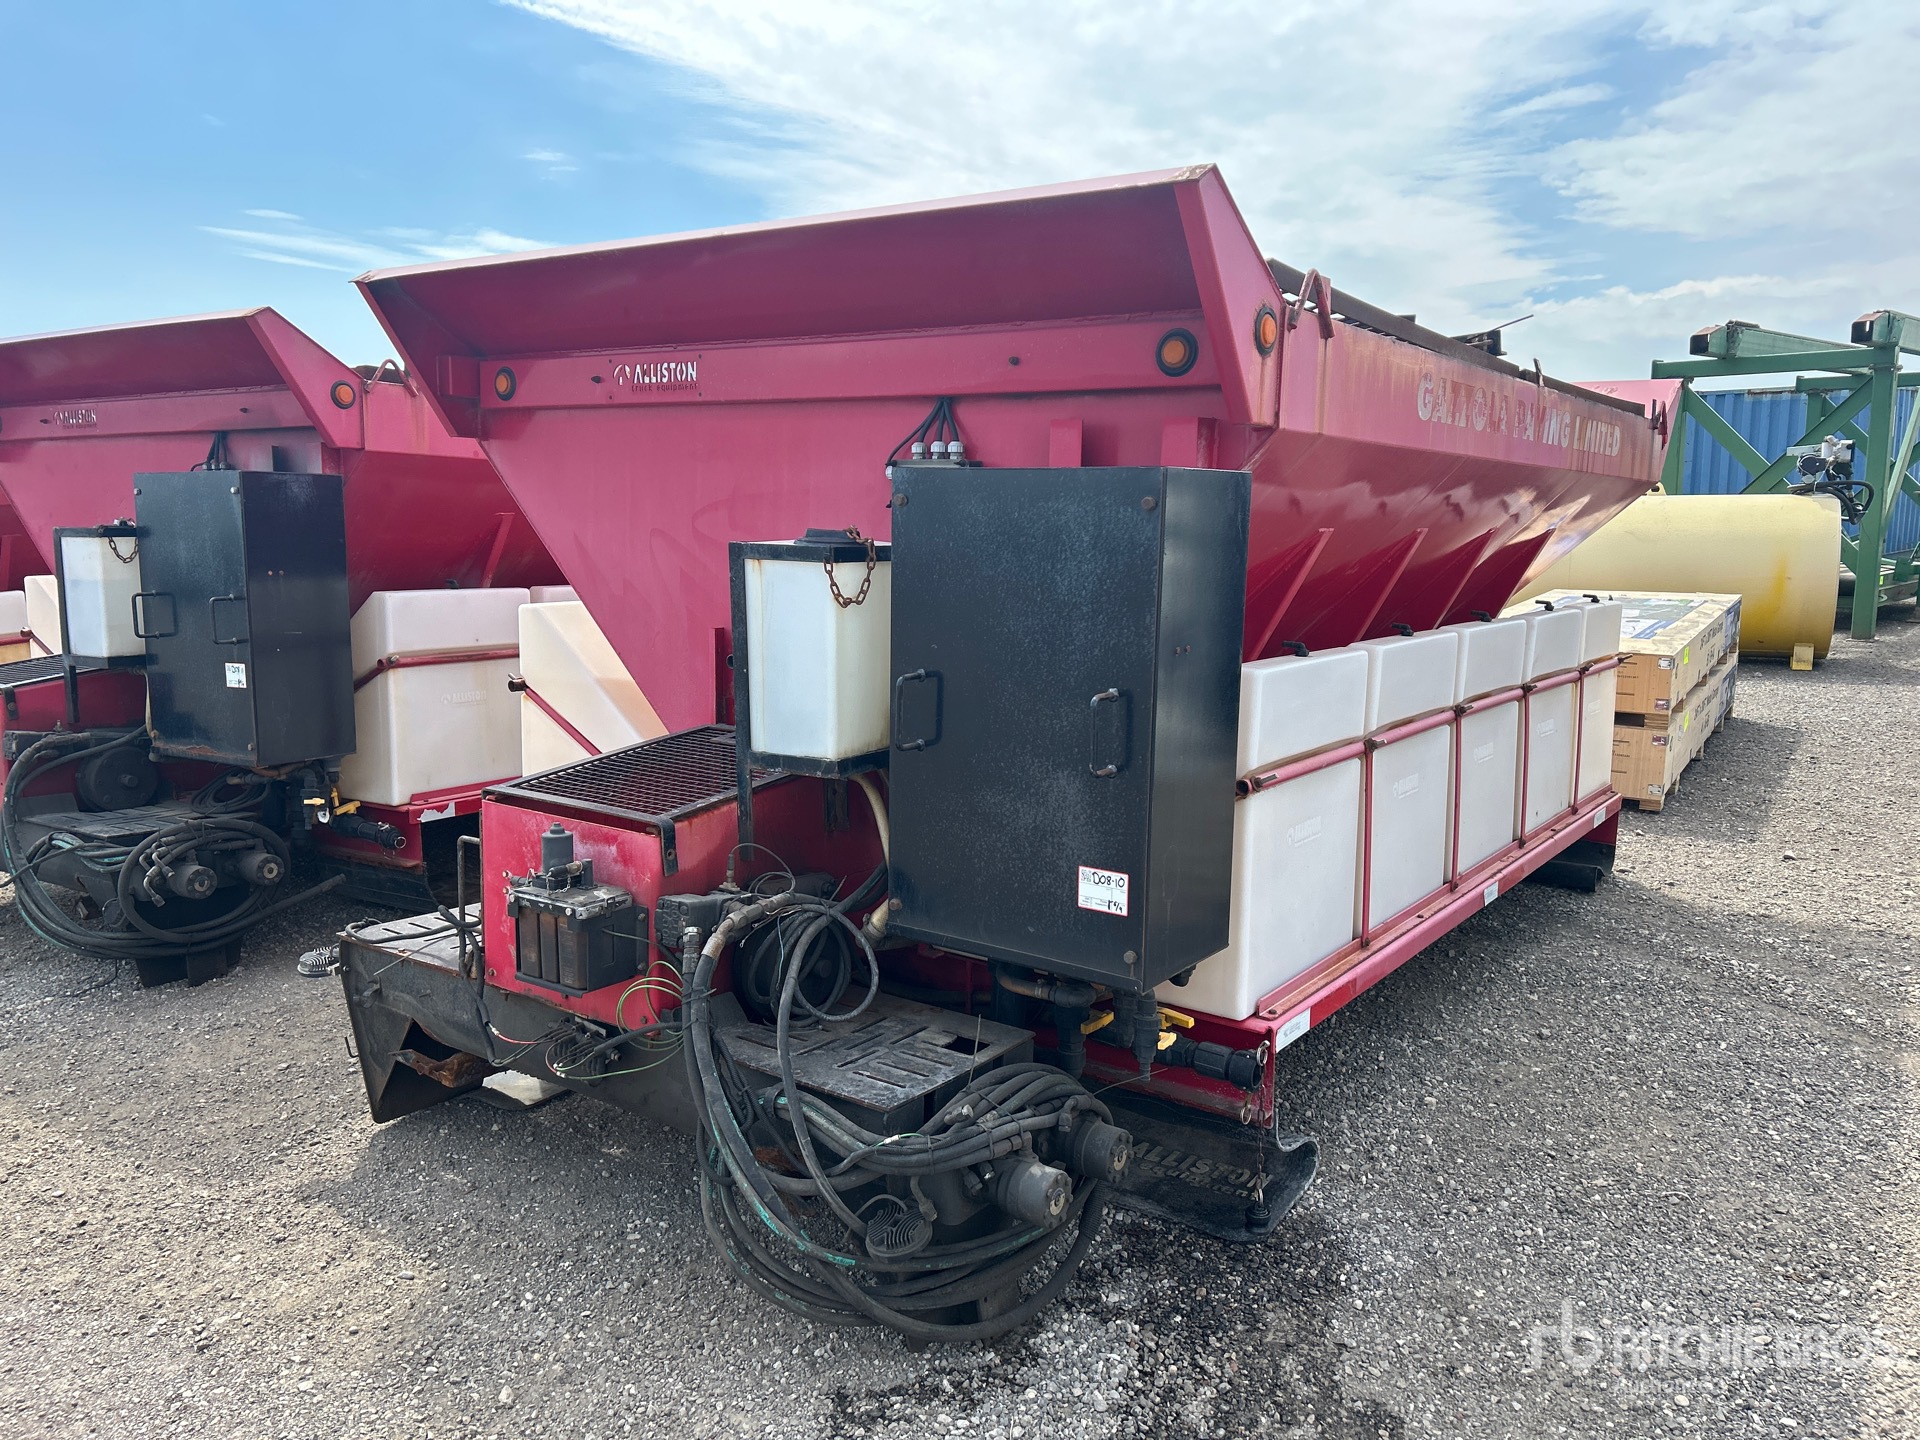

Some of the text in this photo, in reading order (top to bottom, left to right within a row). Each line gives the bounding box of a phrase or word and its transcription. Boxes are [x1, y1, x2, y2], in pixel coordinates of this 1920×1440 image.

[633, 361, 698, 384] ALLISTON
[631, 382, 698, 393] truck equipment
[63, 409, 97, 424] ALLISTON
[1513, 399, 1571, 448] PAVING
[1573, 414, 1622, 457] LIMITED
[1132, 1141, 1273, 1189] ALLISTON
